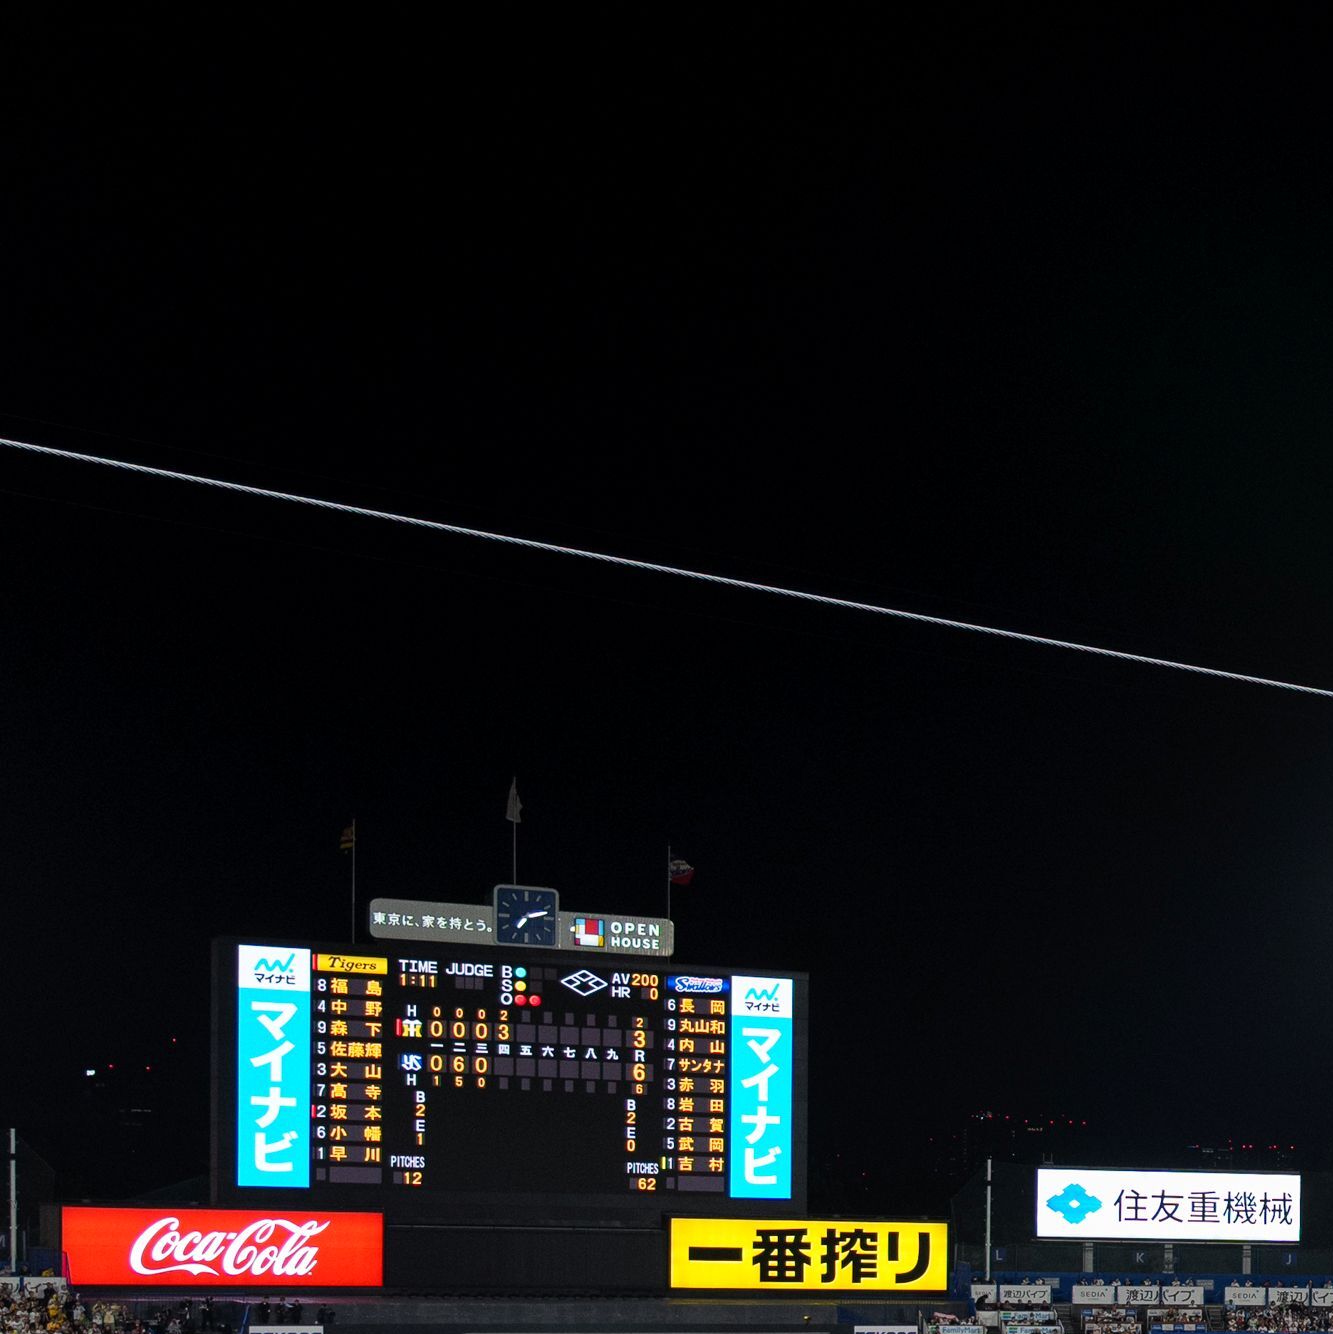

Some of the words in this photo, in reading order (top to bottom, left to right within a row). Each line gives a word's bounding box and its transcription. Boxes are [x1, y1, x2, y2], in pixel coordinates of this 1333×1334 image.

[372, 911, 493, 933] 東京に、家を持とう。
[610, 921, 661, 937] OPEN
[610, 936, 660, 949] HOUSE
[328, 955, 377, 972] Tigers
[399, 959, 437, 973] TIME
[446, 963, 493, 977] JUDGE
[502, 965, 512, 978] B
[253, 973, 297, 985] マイナビ
[318, 979, 326, 991] 8
[400, 974, 434, 987] 1:11
[612, 973, 630, 984] AV
[632, 974, 658, 986] 200
[502, 979, 513, 992] S
[501, 993, 512, 1005] O
[612, 986, 630, 998] HR
[650, 988, 658, 1000] 0
[318, 1000, 325, 1012] 4
[668, 999, 675, 1010] 6
[745, 1001, 780, 1012] マイナビ
[318, 1021, 326, 1033] 9
[668, 1019, 675, 1030] 9
[680, 1019, 725, 1034] 丸山和
[430, 1021, 442, 1037] 0
[453, 1022, 465, 1038] 0
[476, 1023, 487, 1039] 0
[498, 1024, 509, 1040] 3
[634, 1030, 645, 1048] 3
[318, 1042, 325, 1054] 5
[330, 1041, 382, 1058] 佐藤輝
[668, 1039, 675, 1050] 4
[635, 1050, 645, 1062] R
[317, 1063, 326, 1075] 3
[430, 1055, 442, 1071] 0
[453, 1056, 464, 1072] 6
[475, 1057, 487, 1073] 0
[633, 1064, 645, 1081] 6
[668, 1058, 675, 1070] 7
[679, 1059, 724, 1073] サンタナ
[250, 1000, 299, 1173] マイナビ
[317, 1084, 325, 1096] 7
[667, 1078, 675, 1090] 3
[667, 1098, 675, 1110] 8
[741, 1027, 783, 1185] マイナビ
[317, 1105, 326, 1117] 2
[667, 1118, 675, 1129] 2
[317, 1126, 326, 1138] 6
[667, 1137, 674, 1149] 5
[318, 1147, 323, 1159] 1
[391, 1156, 425, 1168] PITCHES
[627, 1162, 658, 1174] PITCHES
[404, 1172, 422, 1185] 12
[638, 1178, 656, 1190] 62
[1113, 1187, 1294, 1226] 住友重機械
[130, 1216, 330, 1277] Coca-Cola
[687, 1230, 931, 1285] 一番搾り
